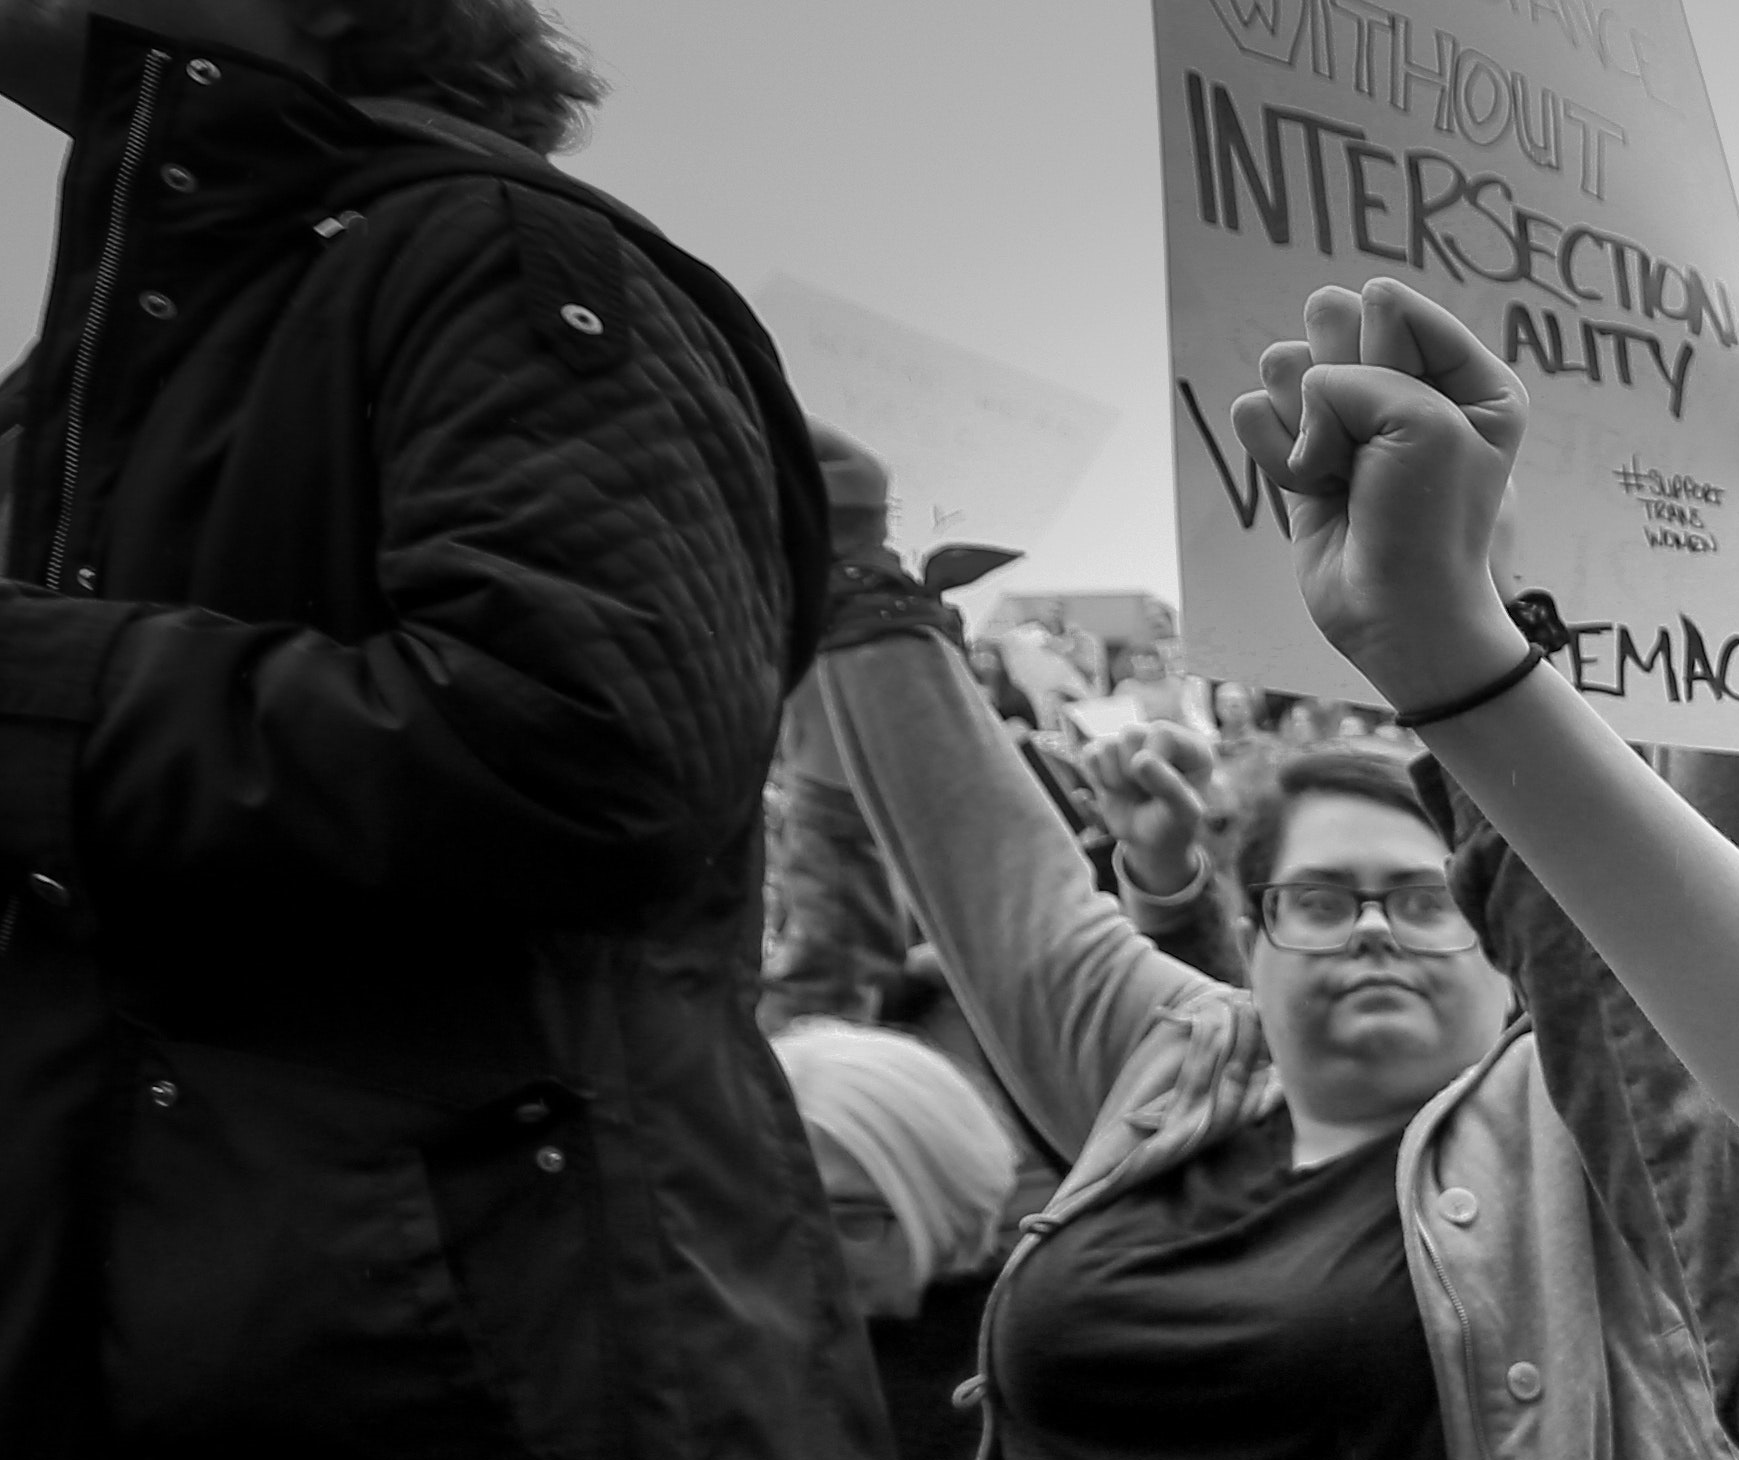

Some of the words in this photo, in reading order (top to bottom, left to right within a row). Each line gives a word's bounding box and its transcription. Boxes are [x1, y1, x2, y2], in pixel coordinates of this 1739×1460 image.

[1215, 0, 1628, 200] WITHOUT
[1184, 70, 1739, 347] INTERSECTION
[1505, 302, 1694, 420] ALITY
